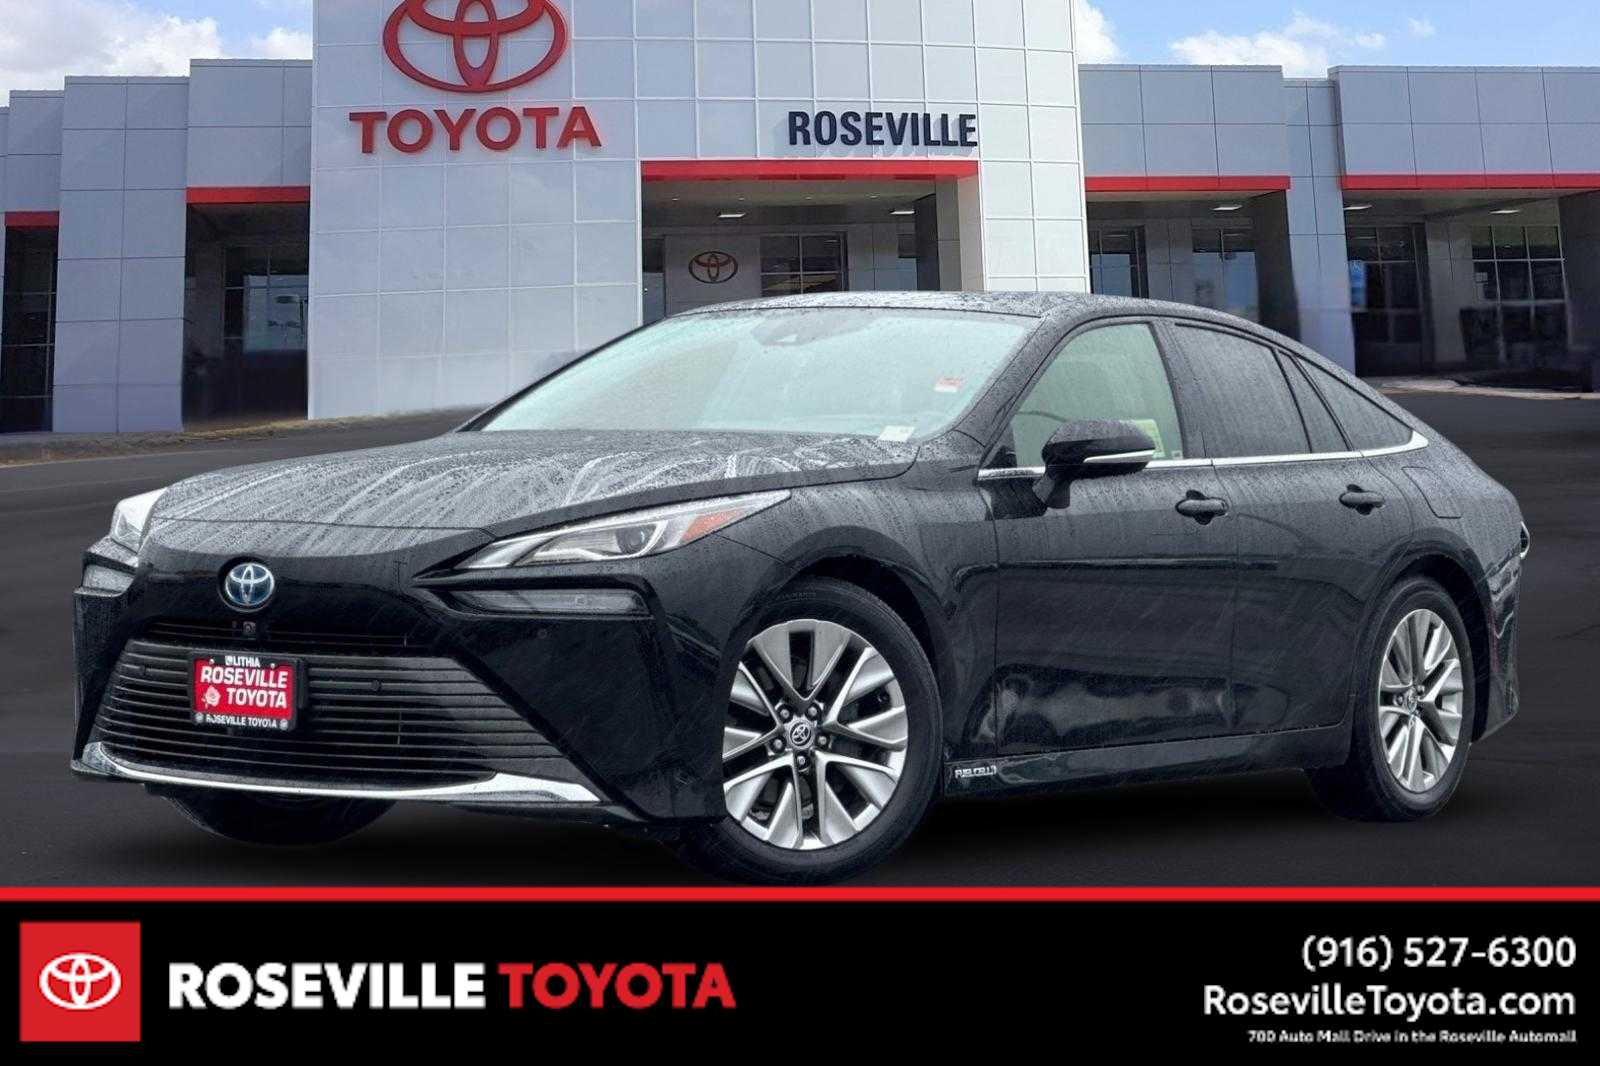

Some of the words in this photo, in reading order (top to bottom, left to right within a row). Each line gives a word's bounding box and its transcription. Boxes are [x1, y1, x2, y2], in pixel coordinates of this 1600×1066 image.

[349, 106, 602, 153] TOYOTA
[788, 110, 978, 147] ROSEVILLE
[233, 655, 261, 668] LITHIA
[200, 665, 288, 689] ROSEVILLE
[226, 687, 287, 709] TOYOTA
[206, 714, 246, 726] ROSEVILLE
[247, 717, 277, 728] TOYOTA
